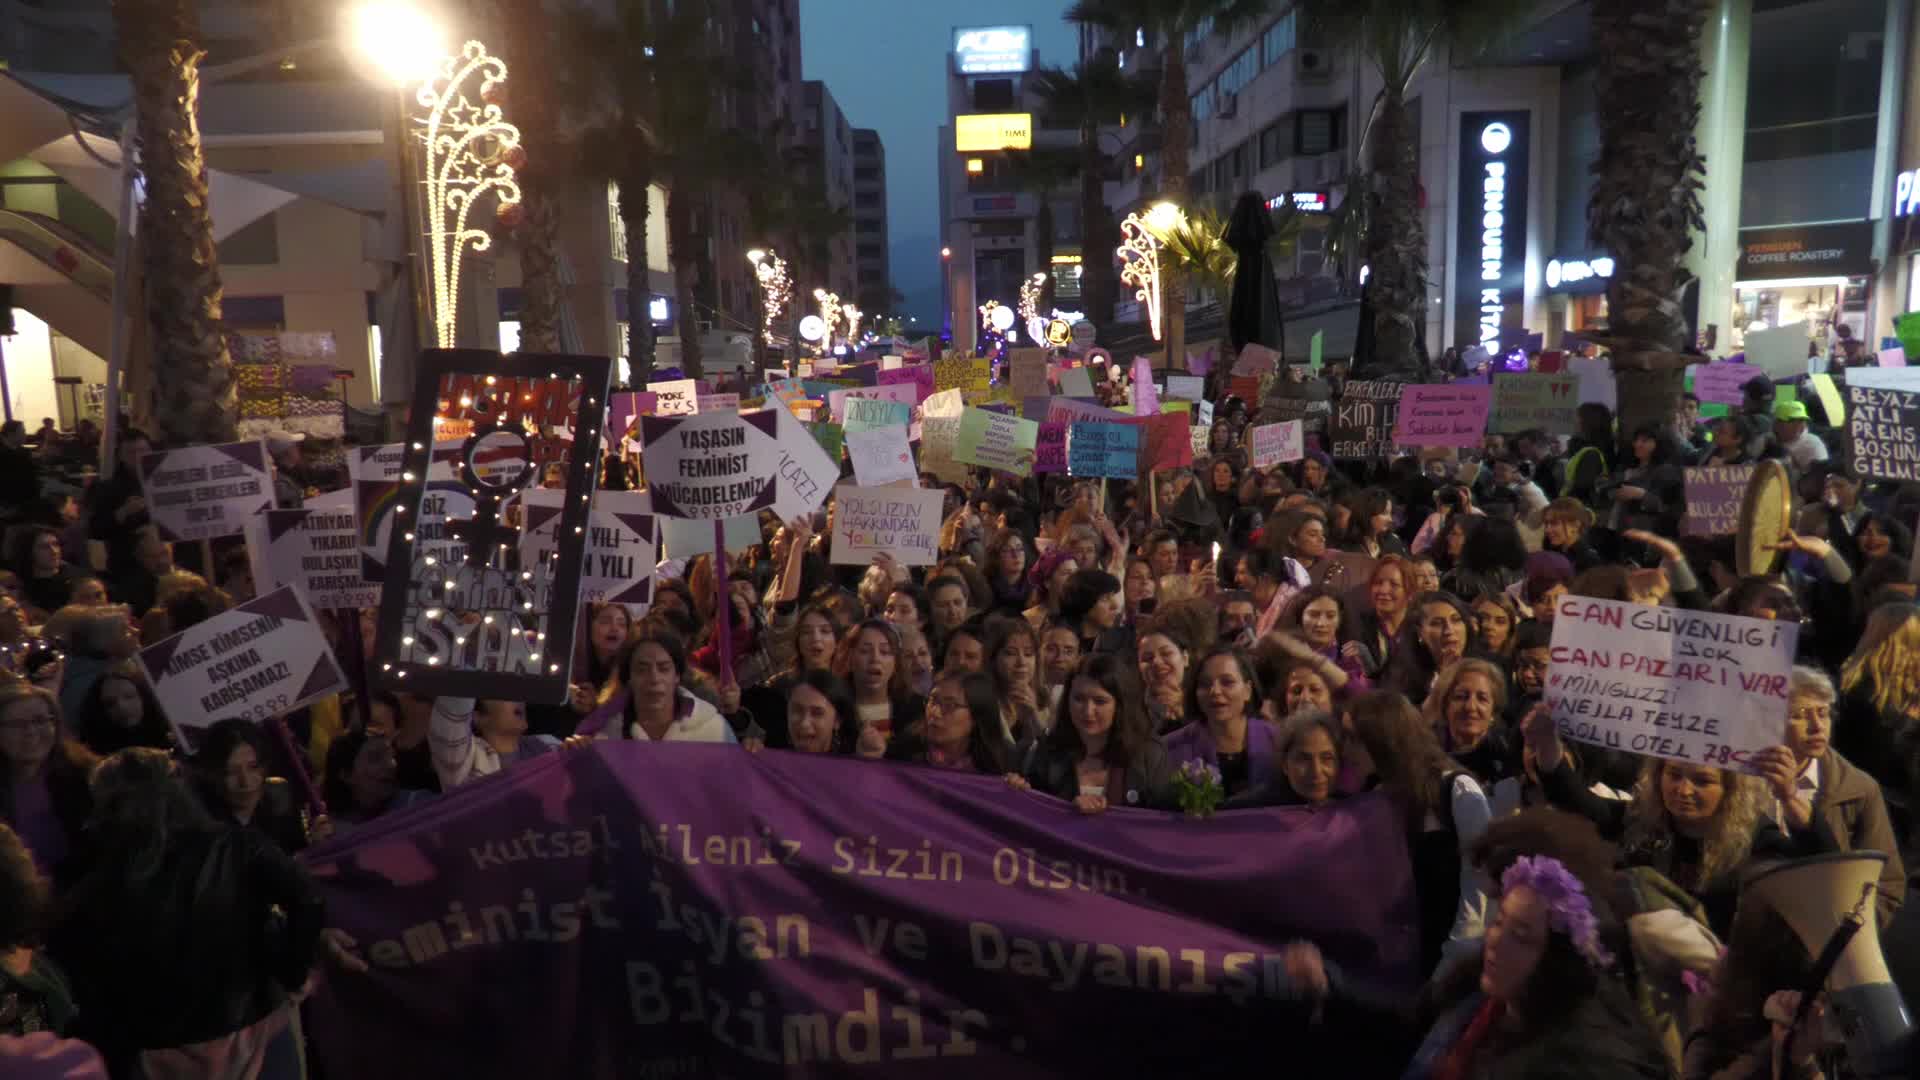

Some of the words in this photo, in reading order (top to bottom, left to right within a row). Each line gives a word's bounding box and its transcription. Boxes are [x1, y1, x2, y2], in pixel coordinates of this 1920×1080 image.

[1747, 253, 1788, 265] COFFEE
[1851, 386, 1919, 409] BEYAZ
[1337, 399, 1376, 430] KİM
[679, 428, 746, 452] YAŞASIN
[1851, 420, 1916, 444] PRENS
[679, 453, 749, 478] FEMİNİST
[659, 475, 768, 506] MÜCADELEMİZ!
[423, 494, 446, 516] BİZ
[591, 527, 620, 548] YILI
[600, 554, 634, 580] YILI
[1560, 601, 1624, 630] CAN
[166, 645, 211, 678] KİMSE
[211, 614, 285, 658] KİMSENİN
[206, 647, 263, 686] AŞKINA
[1550, 646, 1611, 670] CAN
[1738, 671, 1788, 700] VAR
[200, 661, 293, 713] KARIŞAMAZ!
[1643, 709, 1720, 737] TEYZE
[1632, 734, 1690, 760] OTEL
[832, 834, 965, 884] Sizin
[368, 883, 622, 970] eminist
[854, 911, 931, 962] ve
[968, 919, 1296, 1006] Dayanışm
